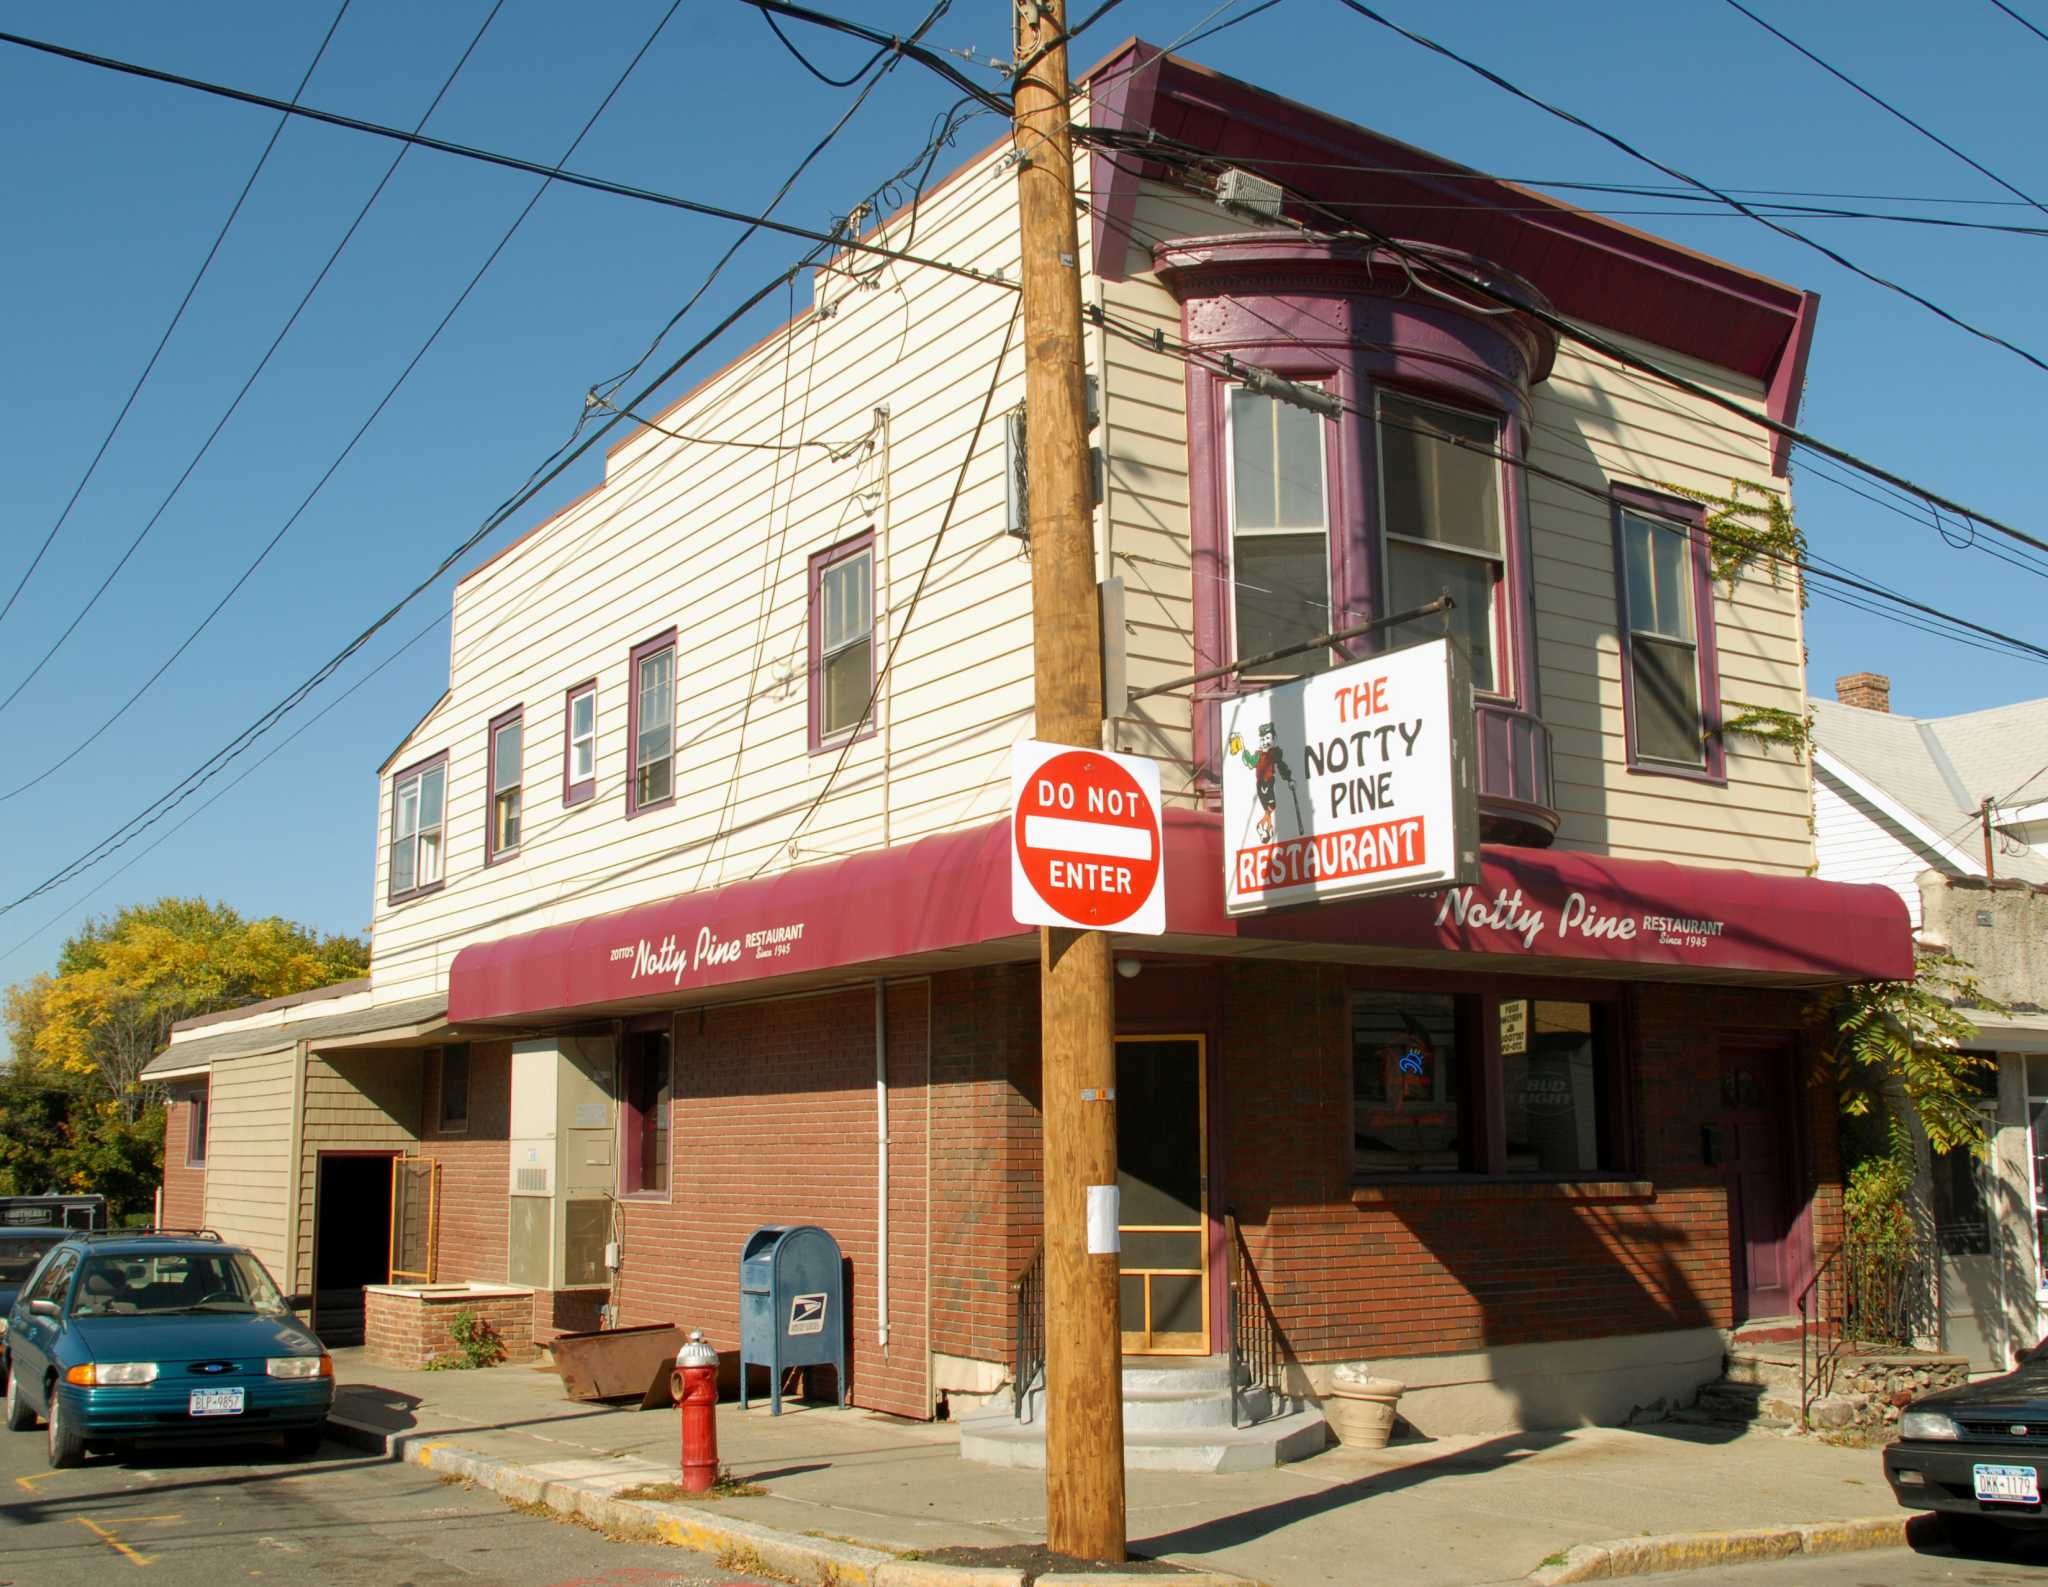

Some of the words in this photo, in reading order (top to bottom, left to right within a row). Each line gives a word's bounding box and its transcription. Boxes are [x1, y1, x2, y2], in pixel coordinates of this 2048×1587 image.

[1335, 676, 1389, 723] THE
[1304, 718, 1423, 779] NOTTY
[1038, 780, 1074, 809] DO
[1088, 786, 1138, 817] NOT
[1331, 772, 1394, 818] PINE
[1050, 860, 1132, 894] ENTER
[1239, 821, 1419, 889] RESTAURANT
[1434, 886, 1544, 948] Notty
[1559, 892, 1636, 940] Pine
[1643, 916, 1724, 936] RESTAURANT
[1659, 932, 1682, 945] Since
[1685, 935, 1708, 948] 1945
[631, 934, 687, 986] Notty
[693, 926, 742, 972] Pine
[745, 923, 805, 949] RESTAURANT
[774, 943, 791, 957] 1945
